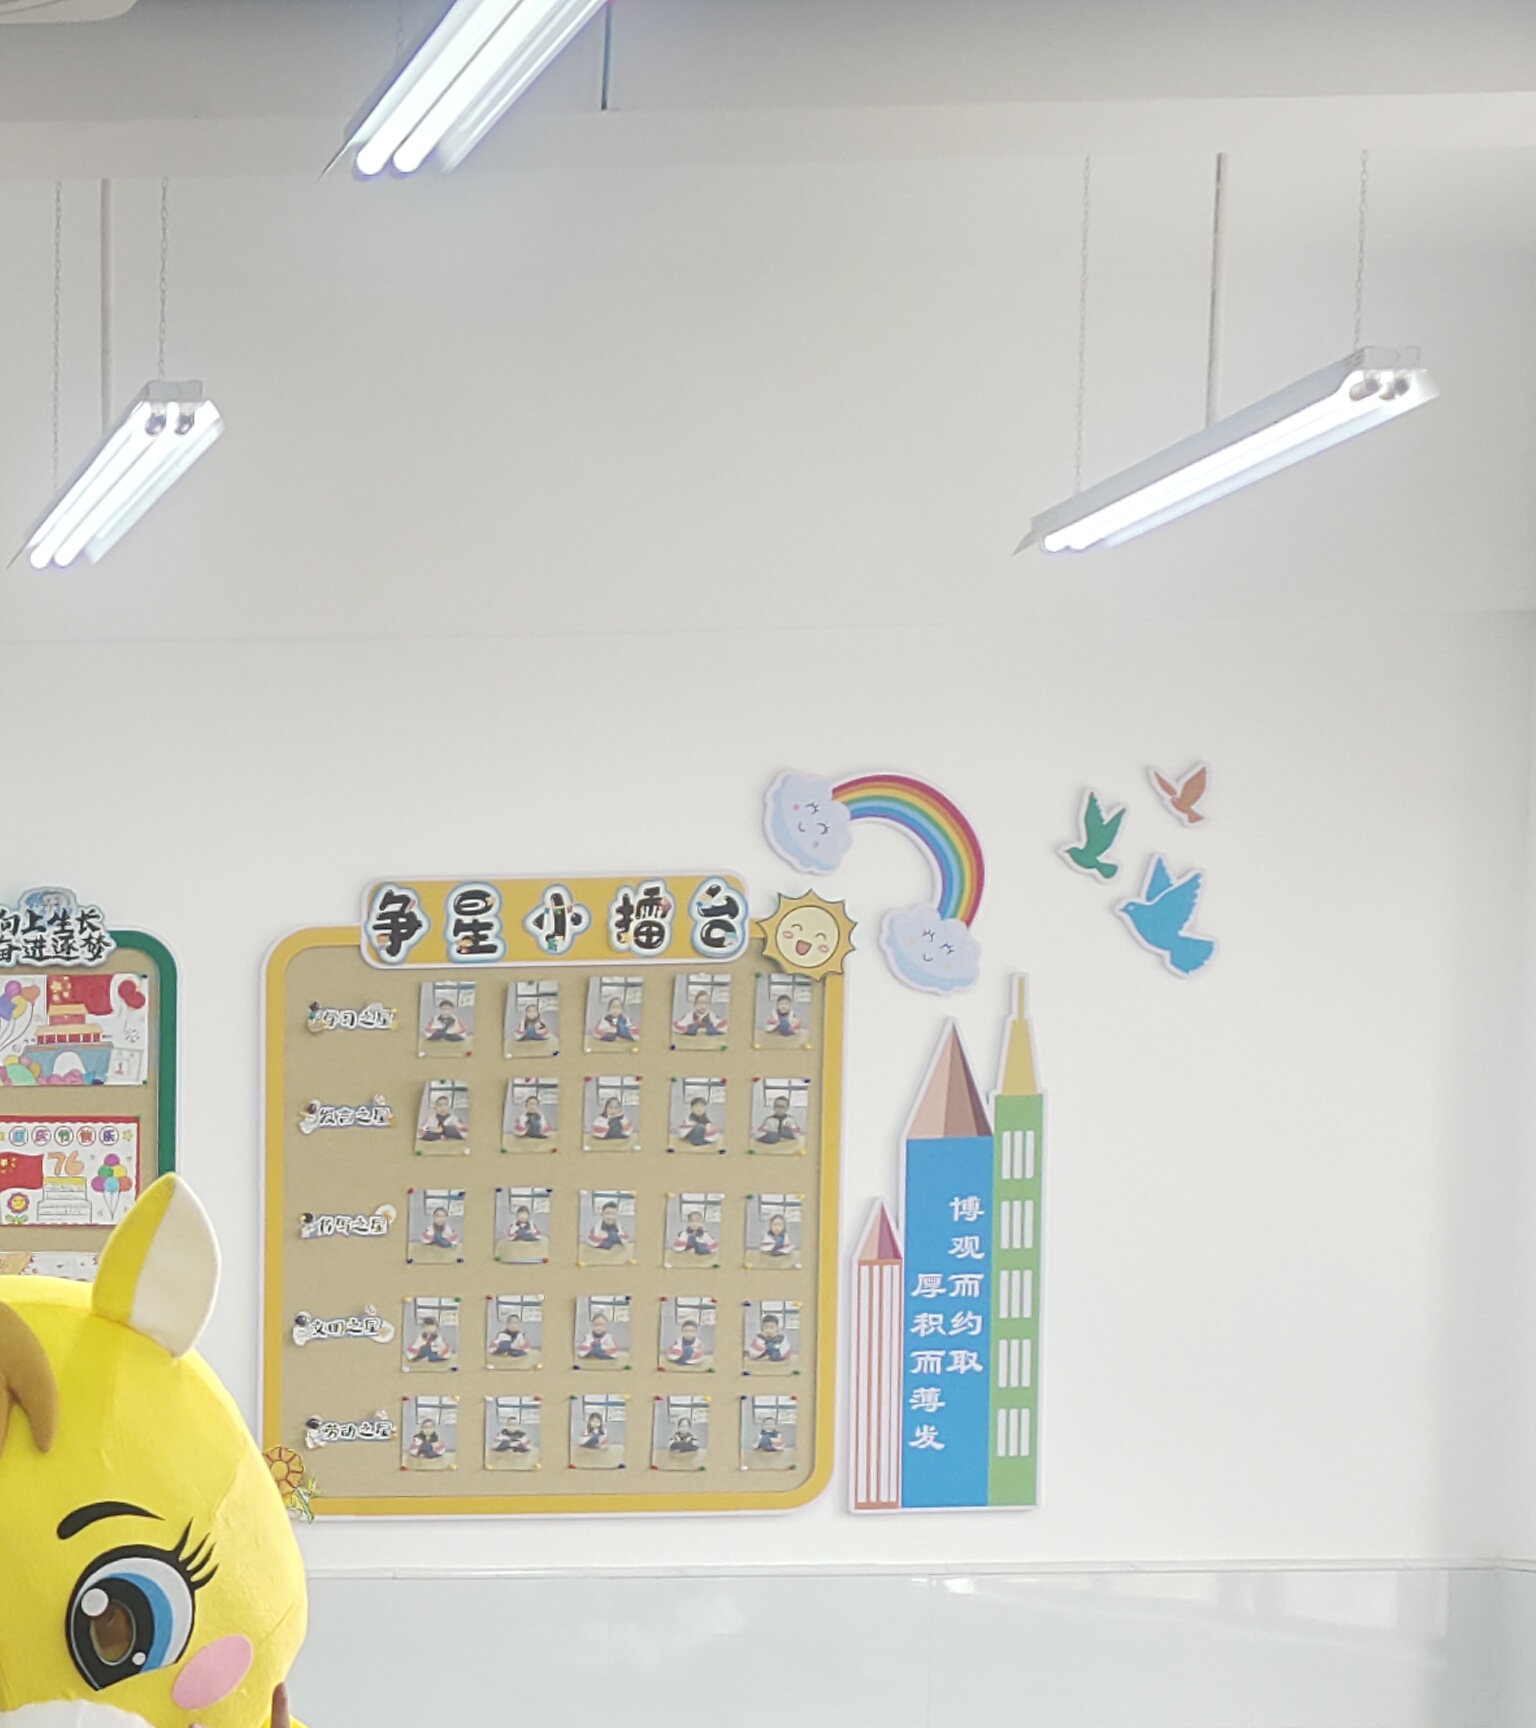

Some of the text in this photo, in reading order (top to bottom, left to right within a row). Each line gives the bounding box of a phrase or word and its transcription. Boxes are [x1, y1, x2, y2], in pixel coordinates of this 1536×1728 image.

[373, 884, 740, 957] 争星小擂台
[47, 1150, 85, 1177] 76
[948, 1195, 985, 1373] 博观而约取
[908, 1272, 947, 1450] 厚积而薄发
